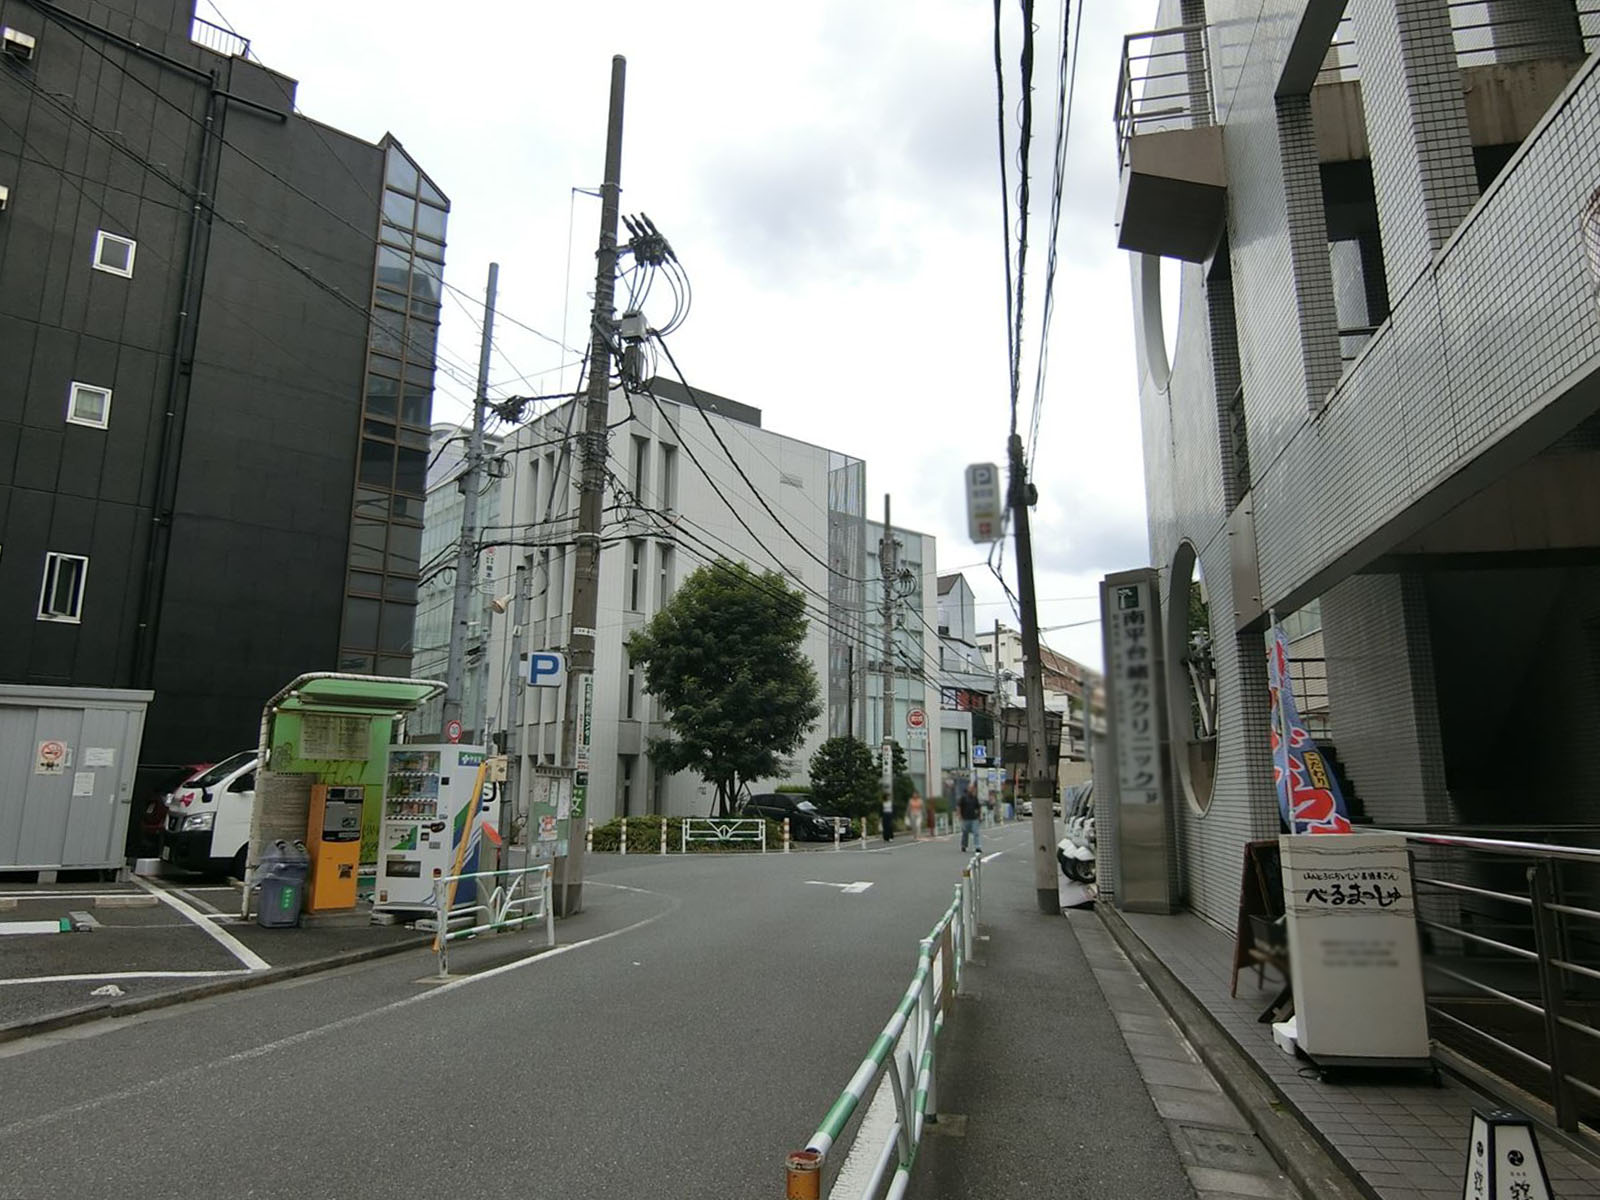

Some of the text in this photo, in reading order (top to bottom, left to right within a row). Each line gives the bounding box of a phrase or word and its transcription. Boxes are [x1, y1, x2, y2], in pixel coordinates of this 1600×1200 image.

[530, 655, 560, 684] P
[1307, 753, 1326, 786] こだわり
[1305, 883, 1402, 907] べるまっしゅ
